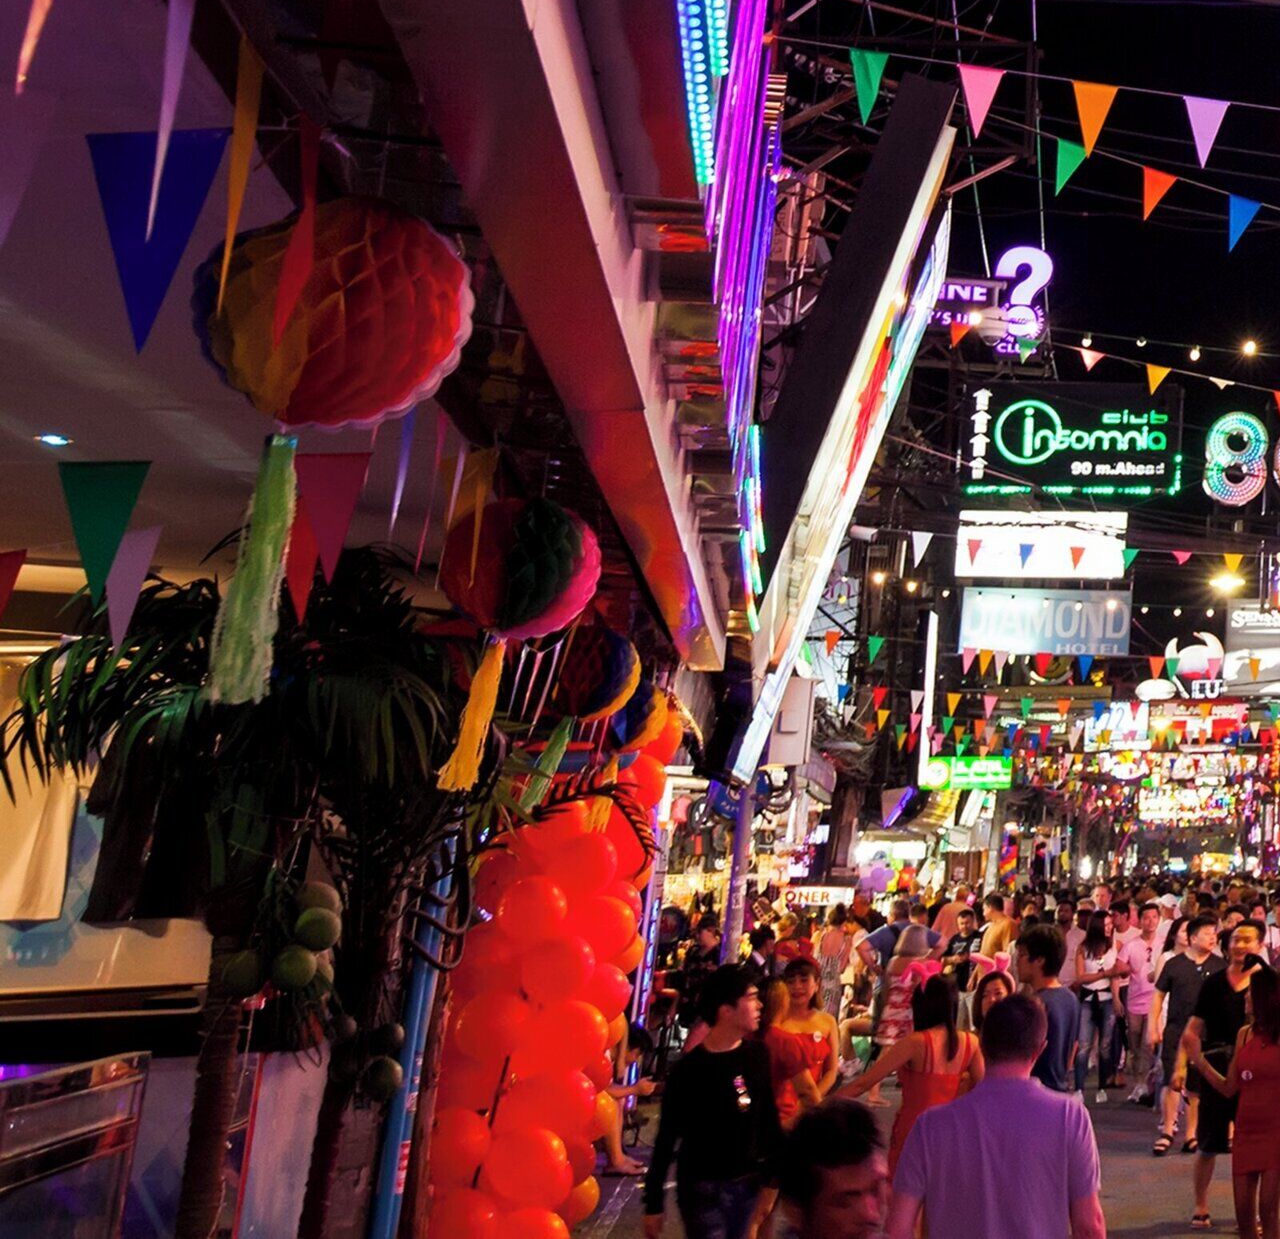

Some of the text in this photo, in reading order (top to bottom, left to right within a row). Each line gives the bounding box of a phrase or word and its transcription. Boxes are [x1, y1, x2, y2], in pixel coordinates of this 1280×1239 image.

[1102, 410, 1168, 424] club
[1071, 462, 1092, 475] 90
[963, 589, 1130, 643] DIAMOND
[1056, 642, 1122, 656] HOTEL
